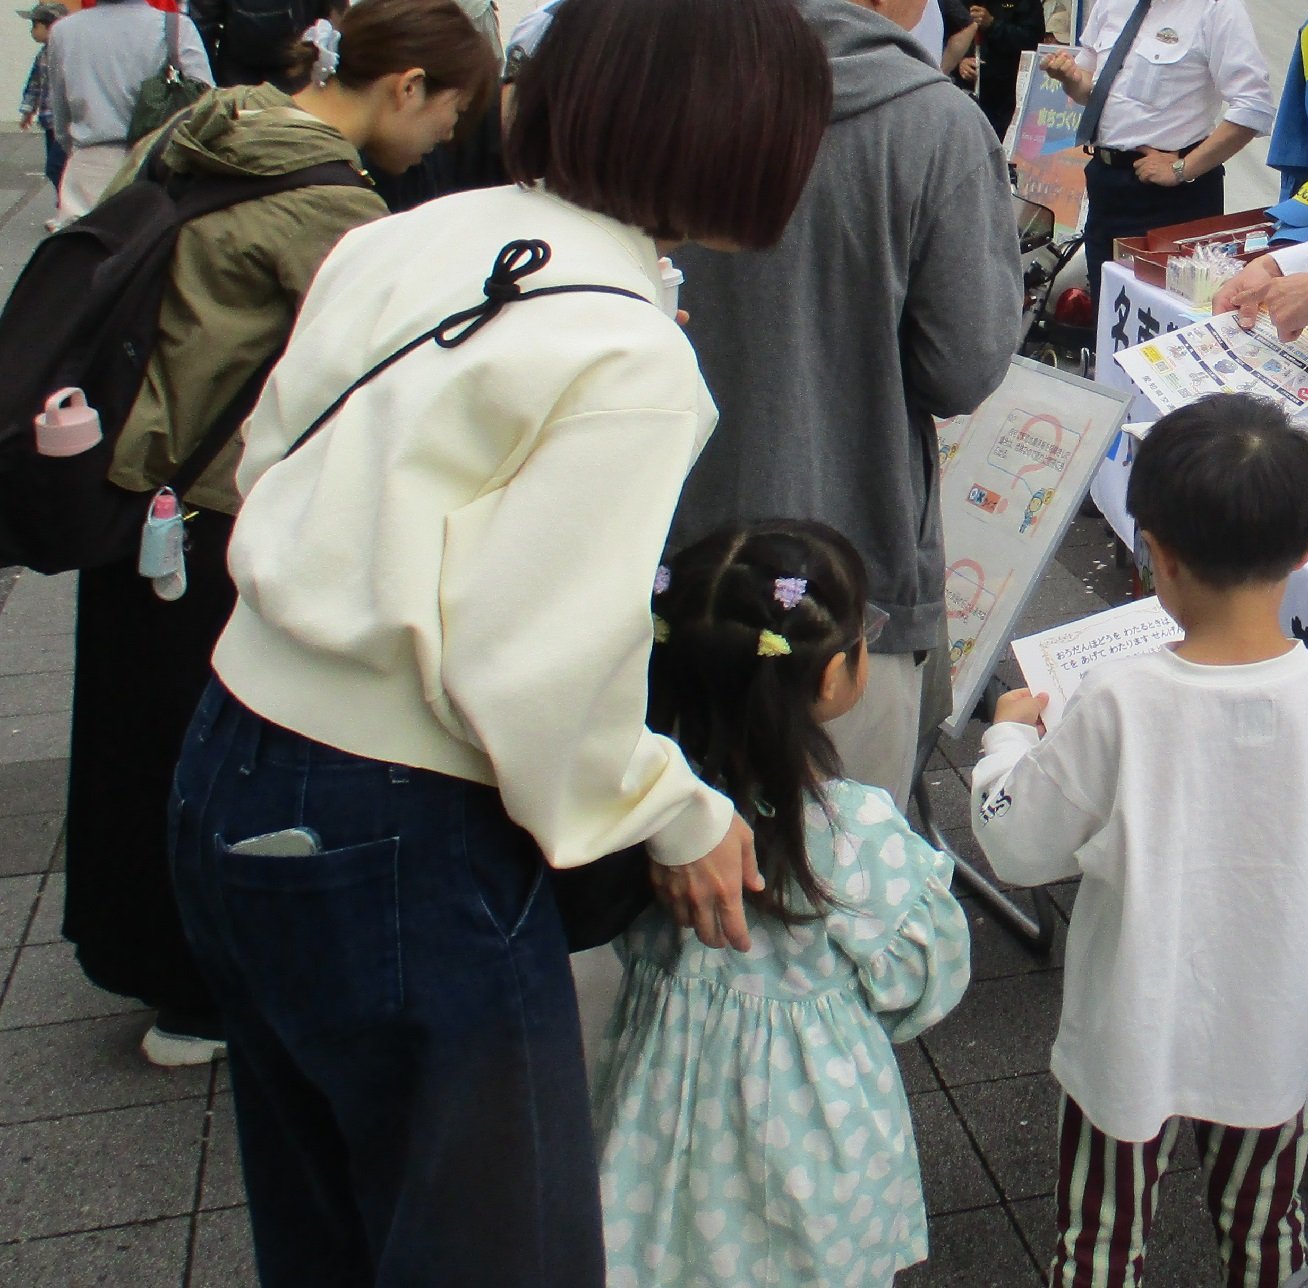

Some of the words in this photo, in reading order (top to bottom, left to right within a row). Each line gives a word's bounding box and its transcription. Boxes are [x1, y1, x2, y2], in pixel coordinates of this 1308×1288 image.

[1056, 632, 1122, 661] おうだんほどうを
[1123, 617, 1171, 637] わたるときは
[1060, 658, 1079, 671] てを
[1080, 648, 1108, 665] あげて
[1109, 634, 1149, 654] わたります
